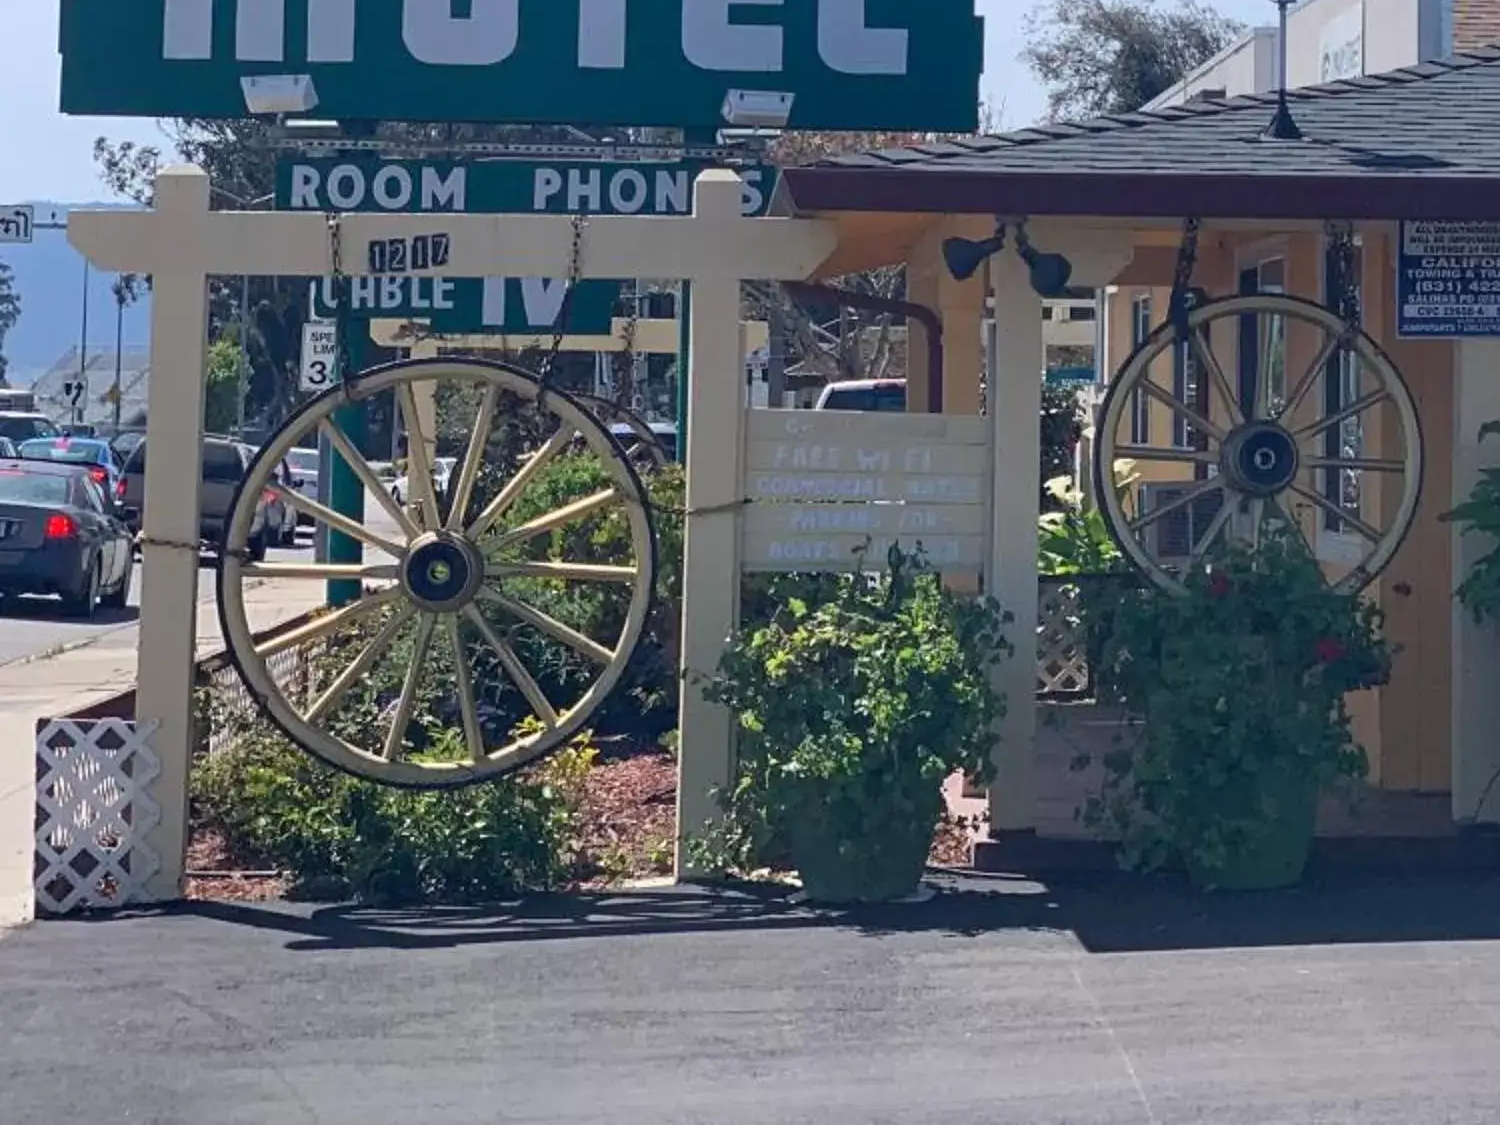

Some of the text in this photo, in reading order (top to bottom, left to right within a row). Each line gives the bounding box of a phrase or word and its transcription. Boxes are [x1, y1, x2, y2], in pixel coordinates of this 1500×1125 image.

[291, 164, 763, 214] ROOM PHONS
[371, 235, 448, 270] 1217
[1407, 269, 1461, 279] TOWING
